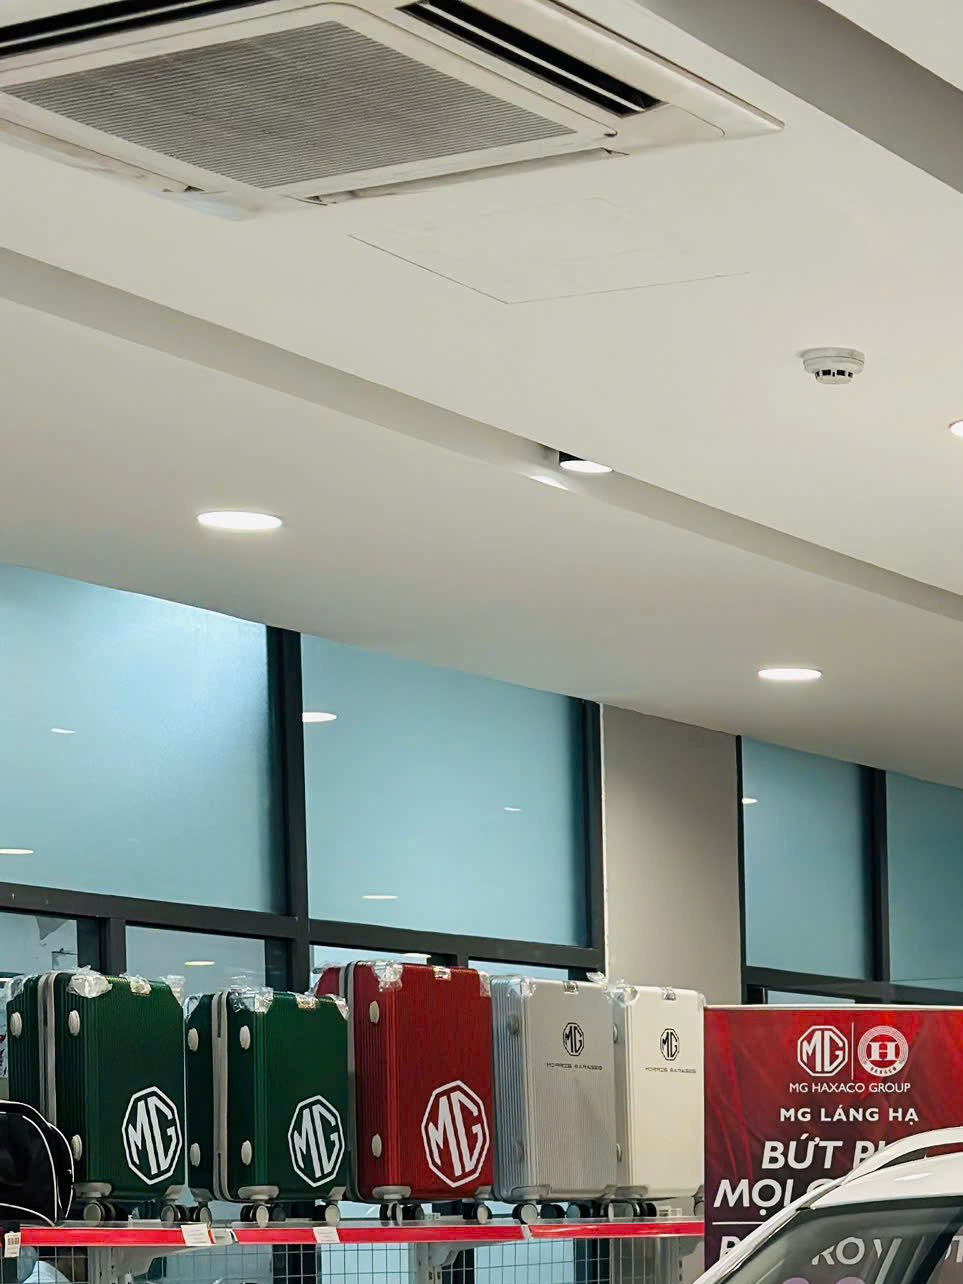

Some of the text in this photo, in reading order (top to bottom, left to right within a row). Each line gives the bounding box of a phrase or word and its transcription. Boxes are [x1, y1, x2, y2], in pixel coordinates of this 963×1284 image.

[563, 1023, 584, 1056] MG
[660, 1029, 679, 1060] MG
[800, 1028, 846, 1074] MG
[868, 1041, 899, 1061] H
[789, 1082, 911, 1093] MG HAXACO GROUP
[780, 1104, 919, 1125] MG LÁNG HẠ
[125, 1092, 179, 1179] MG
[291, 1100, 341, 1181] MG
[426, 1088, 484, 1179] MG
[761, 1133, 844, 1170] BỨT
[713, 1178, 794, 1217] MỌI
